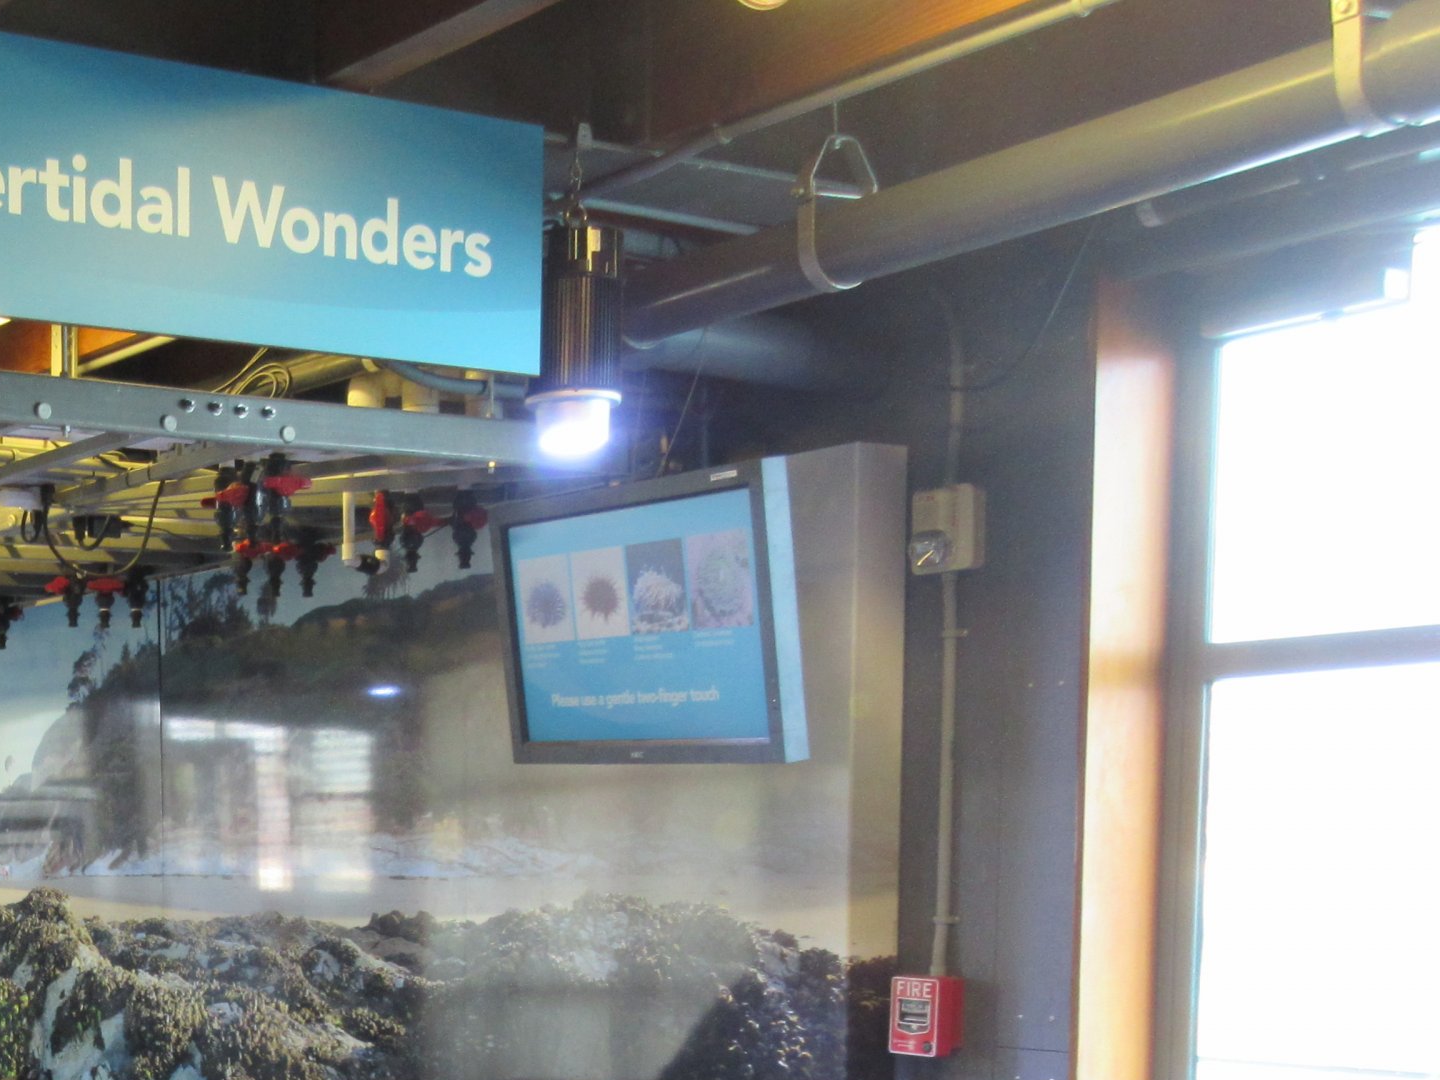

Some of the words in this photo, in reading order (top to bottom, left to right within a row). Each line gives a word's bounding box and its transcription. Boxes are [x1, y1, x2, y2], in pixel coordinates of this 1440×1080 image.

[213, 175, 492, 278] Wonders
[551, 693, 579, 707] Please
[581, 696, 597, 706] use
[607, 690, 635, 708] gentle
[637, 688, 687, 707] two-finger
[690, 685, 720, 702] touch
[896, 980, 933, 998] FIRE
